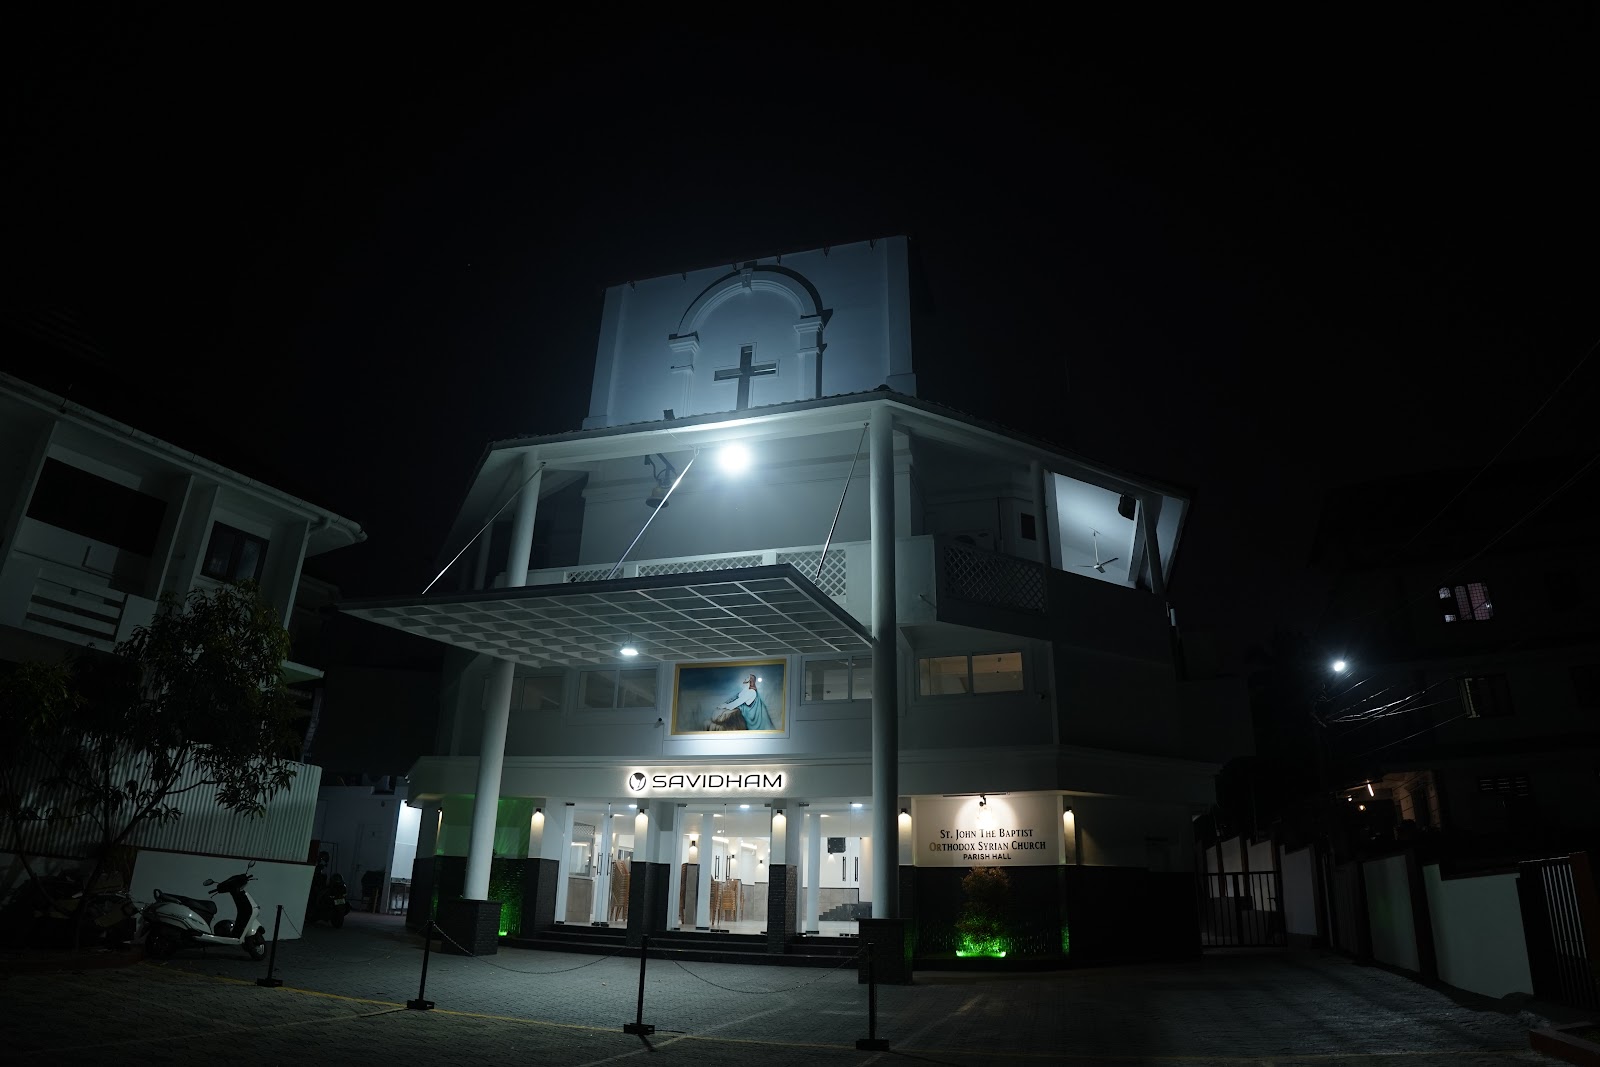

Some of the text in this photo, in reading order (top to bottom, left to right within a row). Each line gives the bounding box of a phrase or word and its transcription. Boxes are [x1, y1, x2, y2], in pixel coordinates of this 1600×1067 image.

[652, 774, 782, 788] SAVIDHAM
[999, 828, 1033, 838] BAPTIST
[929, 840, 1046, 851] ORTHODOX SYRIAN CHURCH
